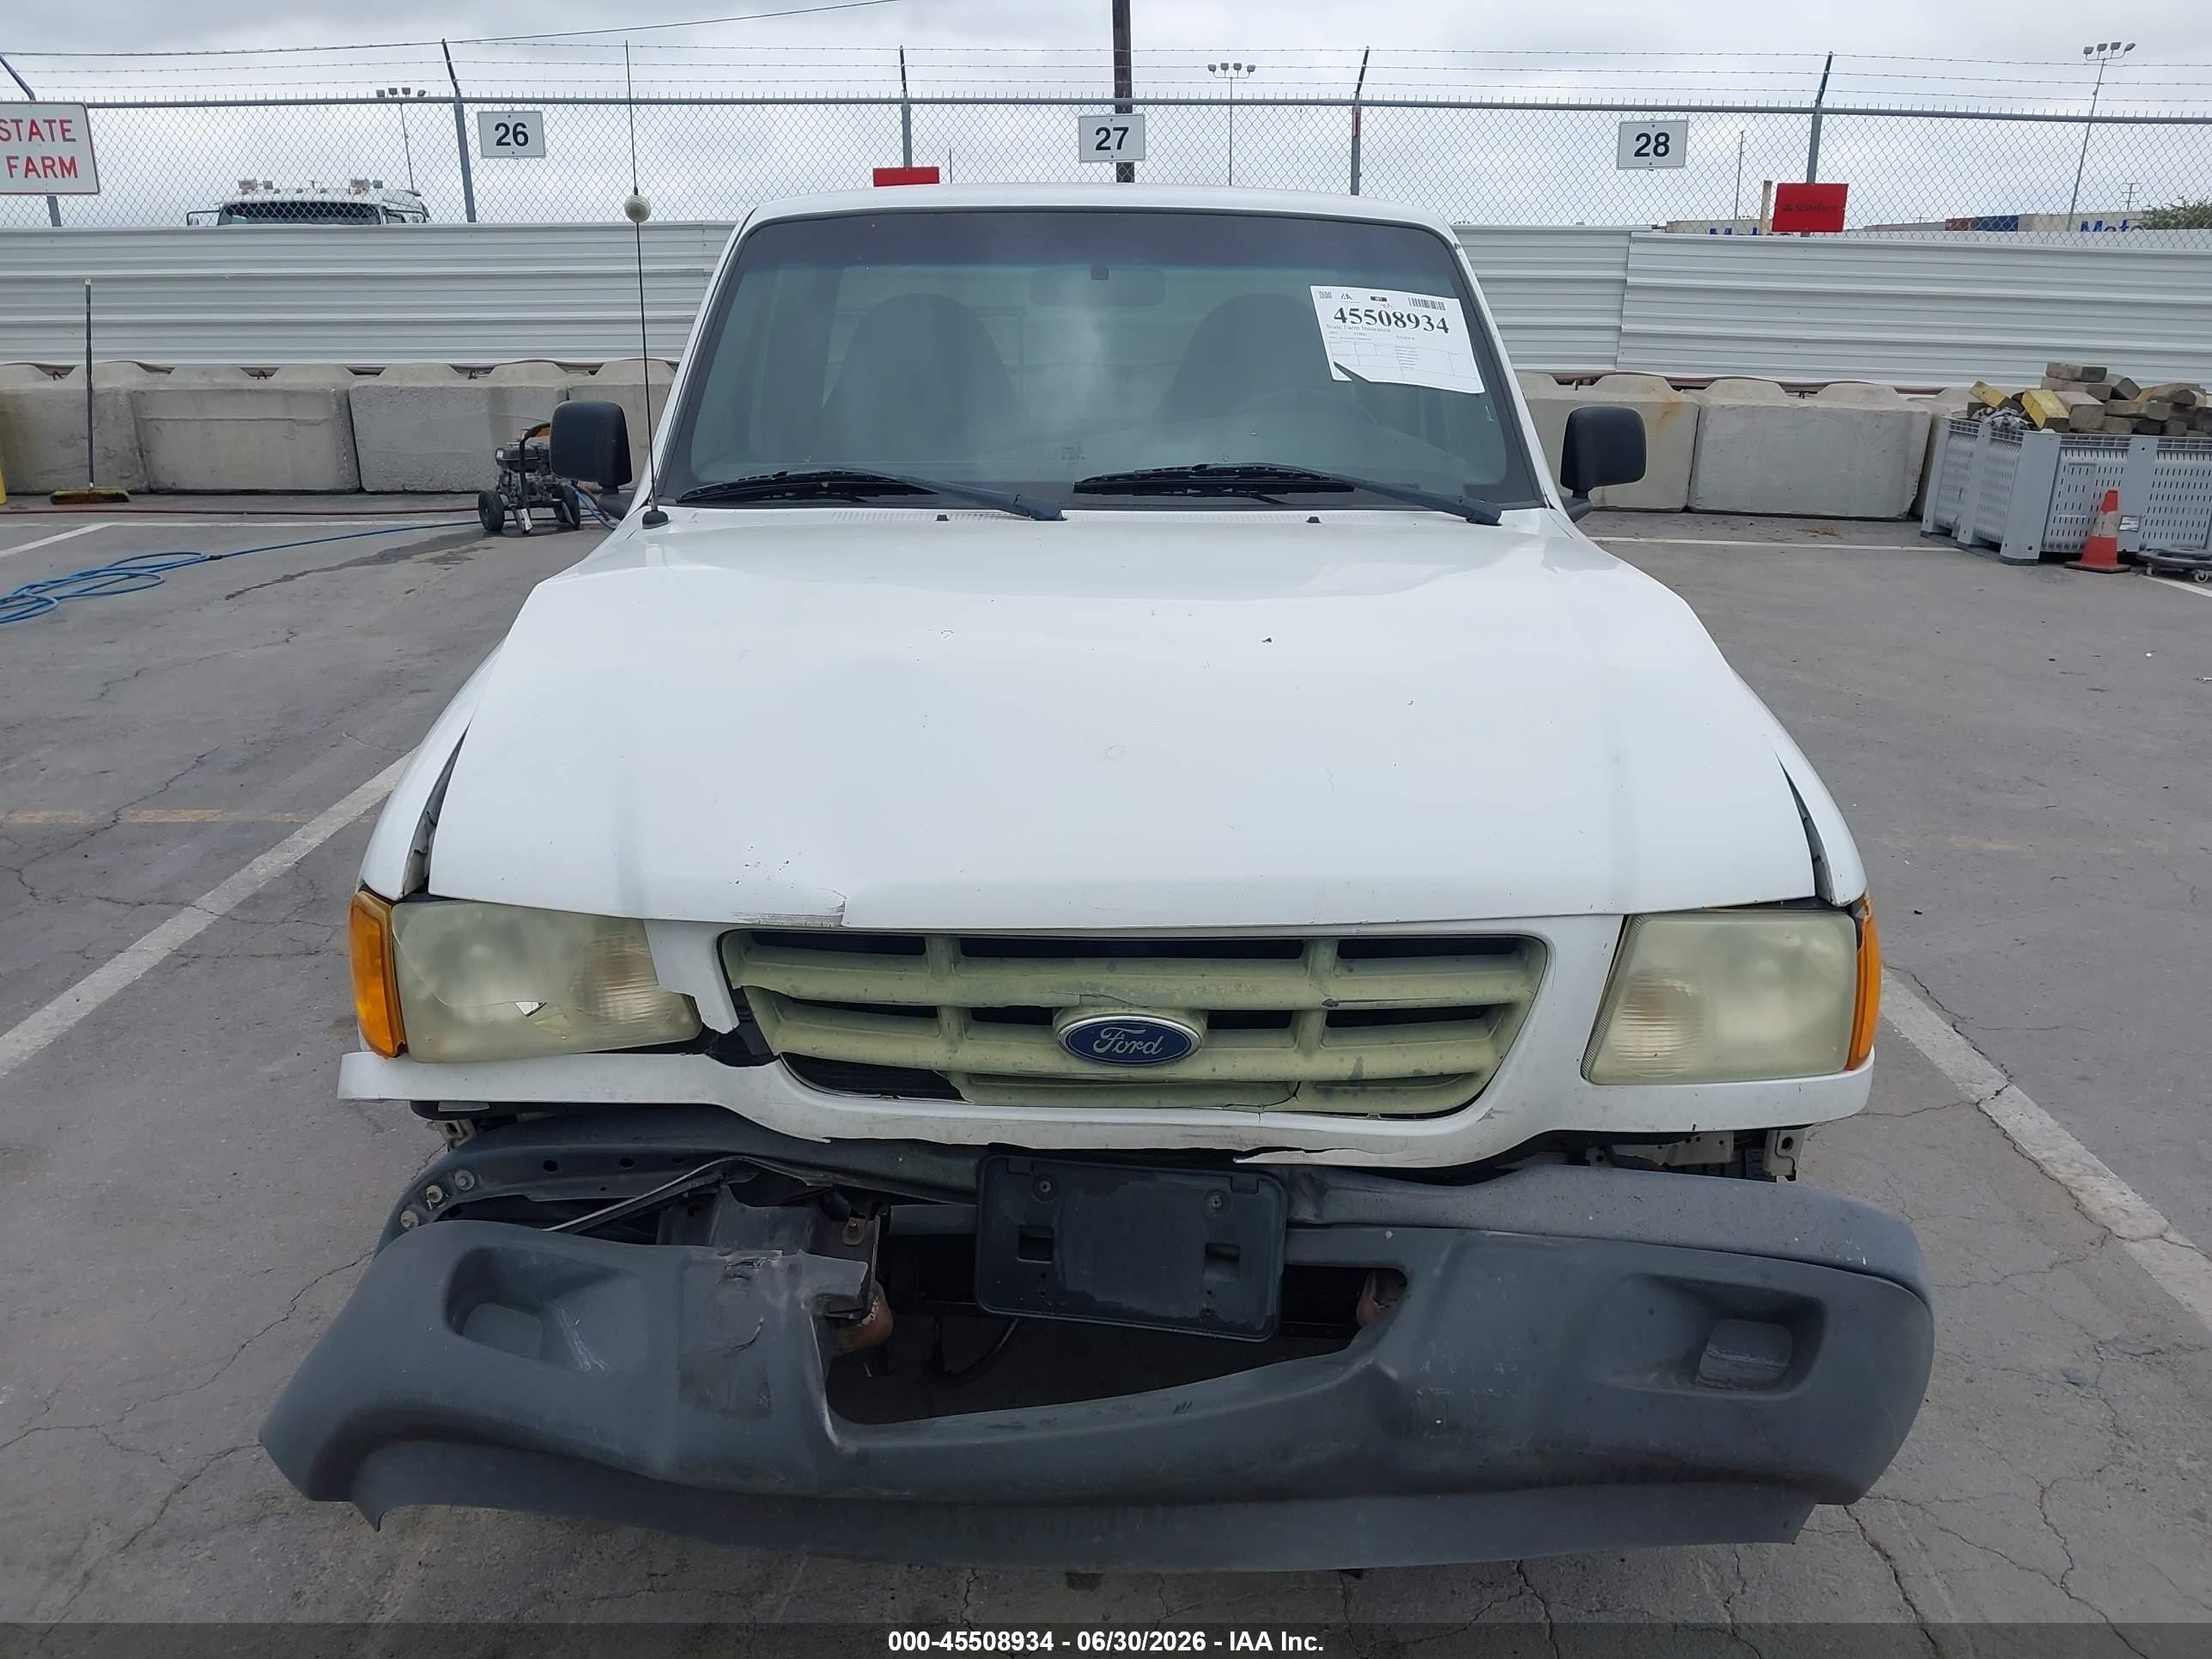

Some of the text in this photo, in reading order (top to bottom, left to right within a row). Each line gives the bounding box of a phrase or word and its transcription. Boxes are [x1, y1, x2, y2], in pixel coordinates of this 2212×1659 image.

[0, 118, 76, 143] STATE
[494, 122, 529, 147] 26
[1095, 126, 1129, 151] 27
[1633, 131, 1670, 157] 28
[5, 155, 79, 179] FARM
[1334, 307, 1449, 334] 45508934
[1092, 1026, 1164, 1054] Ford
